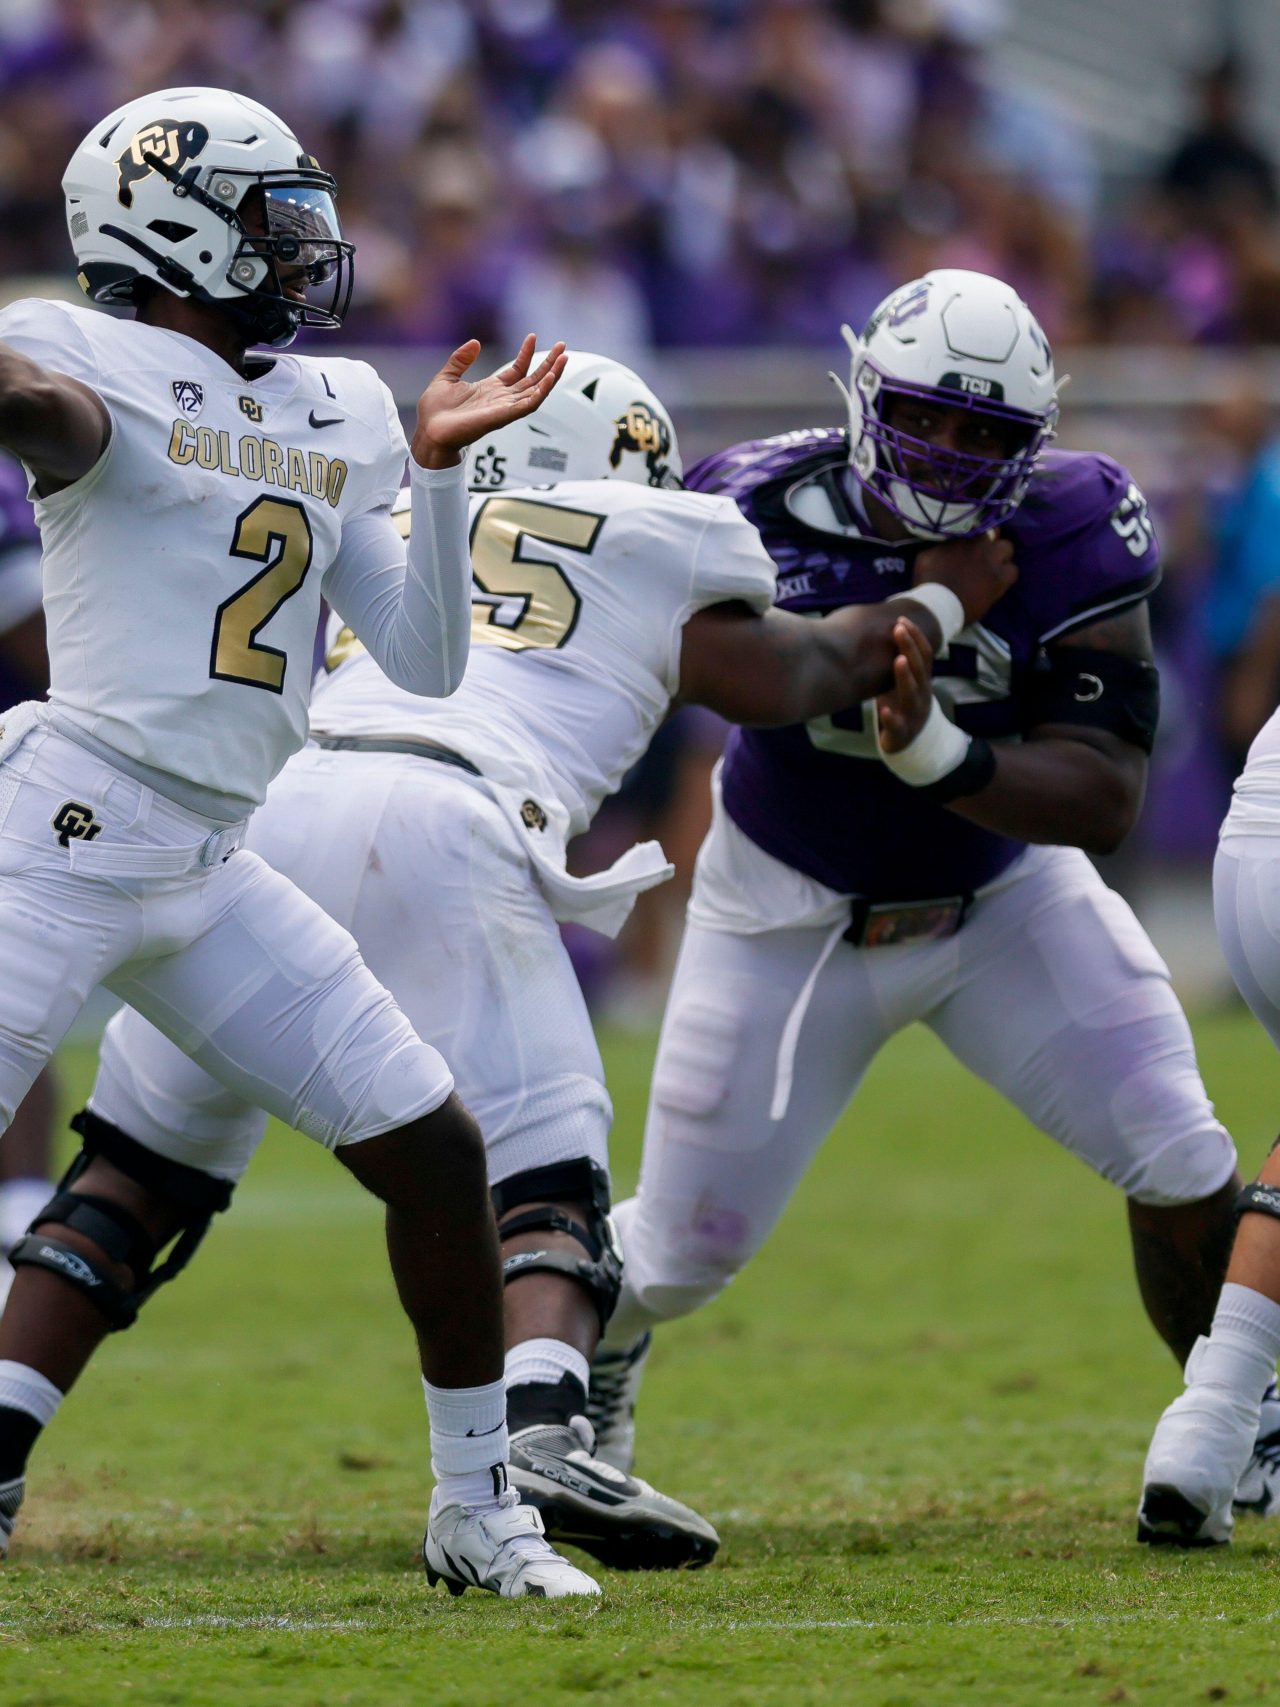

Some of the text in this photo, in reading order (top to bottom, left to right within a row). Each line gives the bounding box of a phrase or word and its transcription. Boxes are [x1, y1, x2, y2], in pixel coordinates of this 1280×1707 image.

[173, 381, 203, 405] PAC
[960, 374, 992, 397] TCU
[181, 396, 201, 413] 12
[238, 395, 263, 422] CU
[167, 418, 349, 509] COLORADO
[473, 454, 507, 486] 55
[209, 493, 314, 696] 2
[531, 1461, 591, 1496] FORCE
